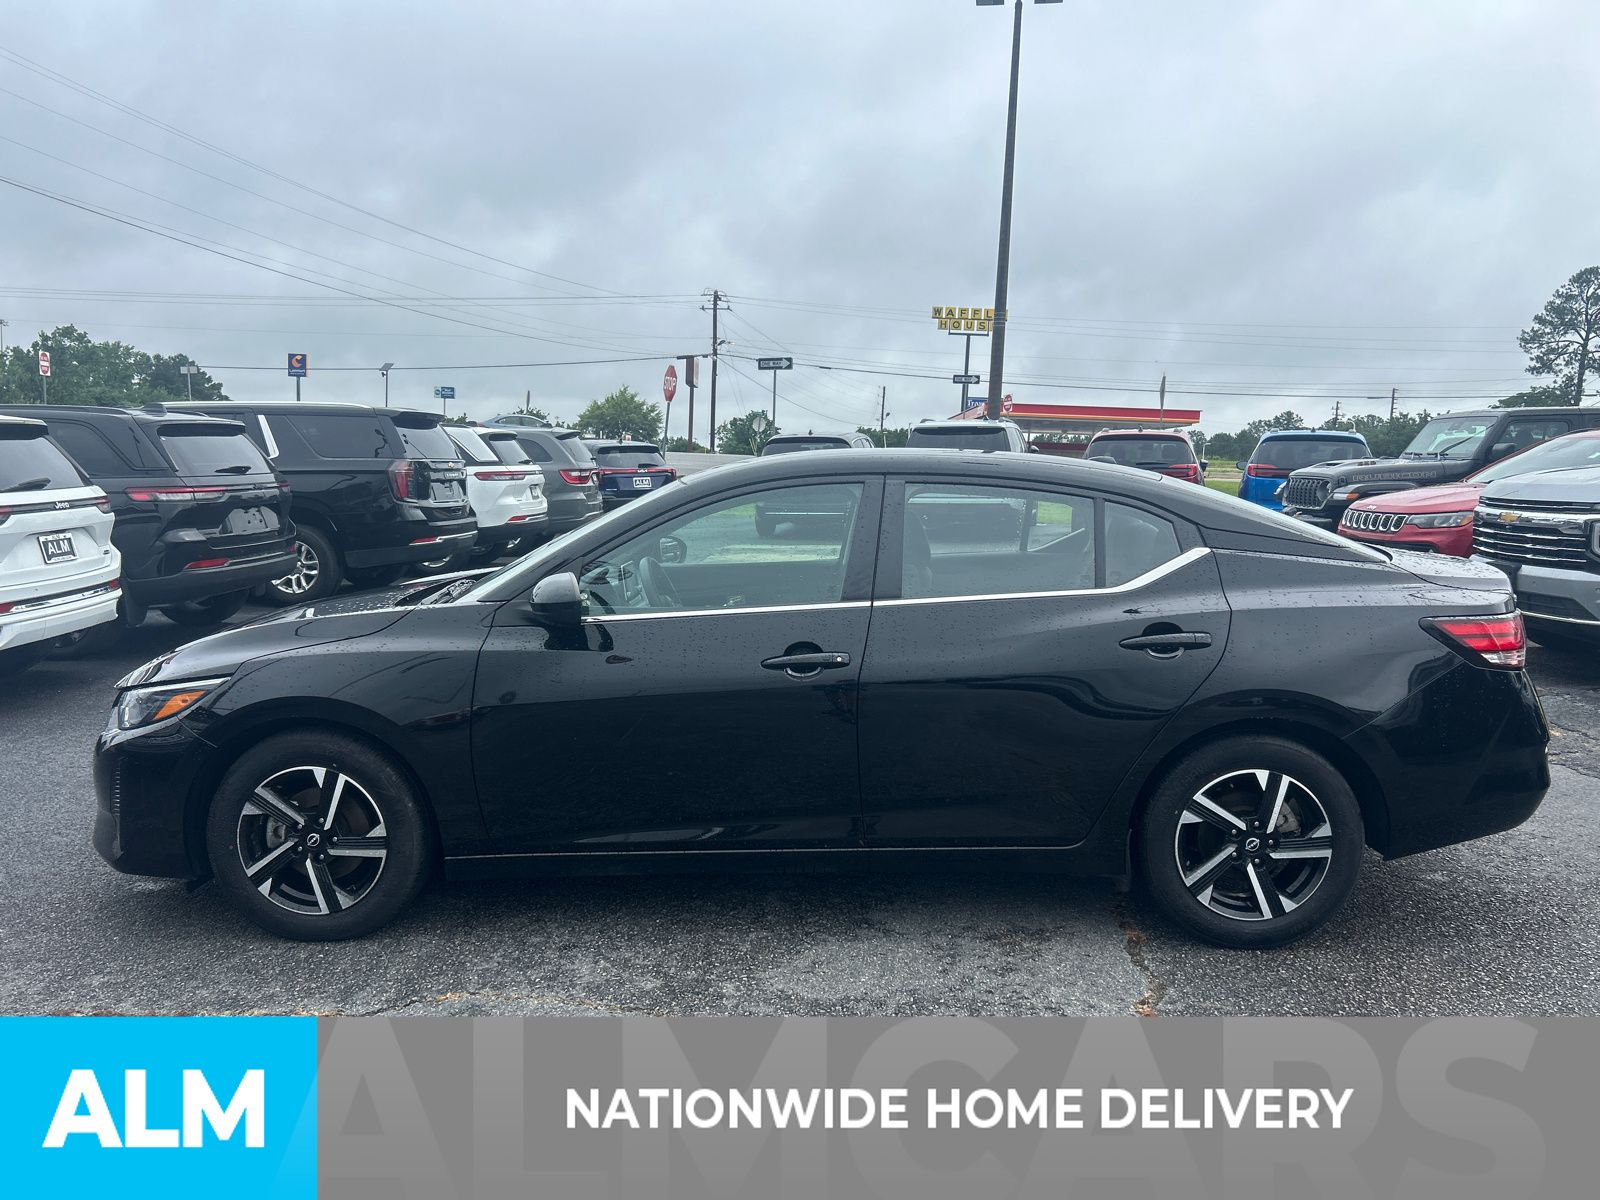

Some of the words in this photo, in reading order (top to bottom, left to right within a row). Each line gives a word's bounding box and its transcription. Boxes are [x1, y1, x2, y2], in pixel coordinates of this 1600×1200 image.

[933, 307, 997, 319] WAFFL
[940, 320, 990, 330] HOUS
[664, 376, 677, 391] STOP
[55, 501, 70, 509] Jeep
[48, 539, 71, 555] ALM
